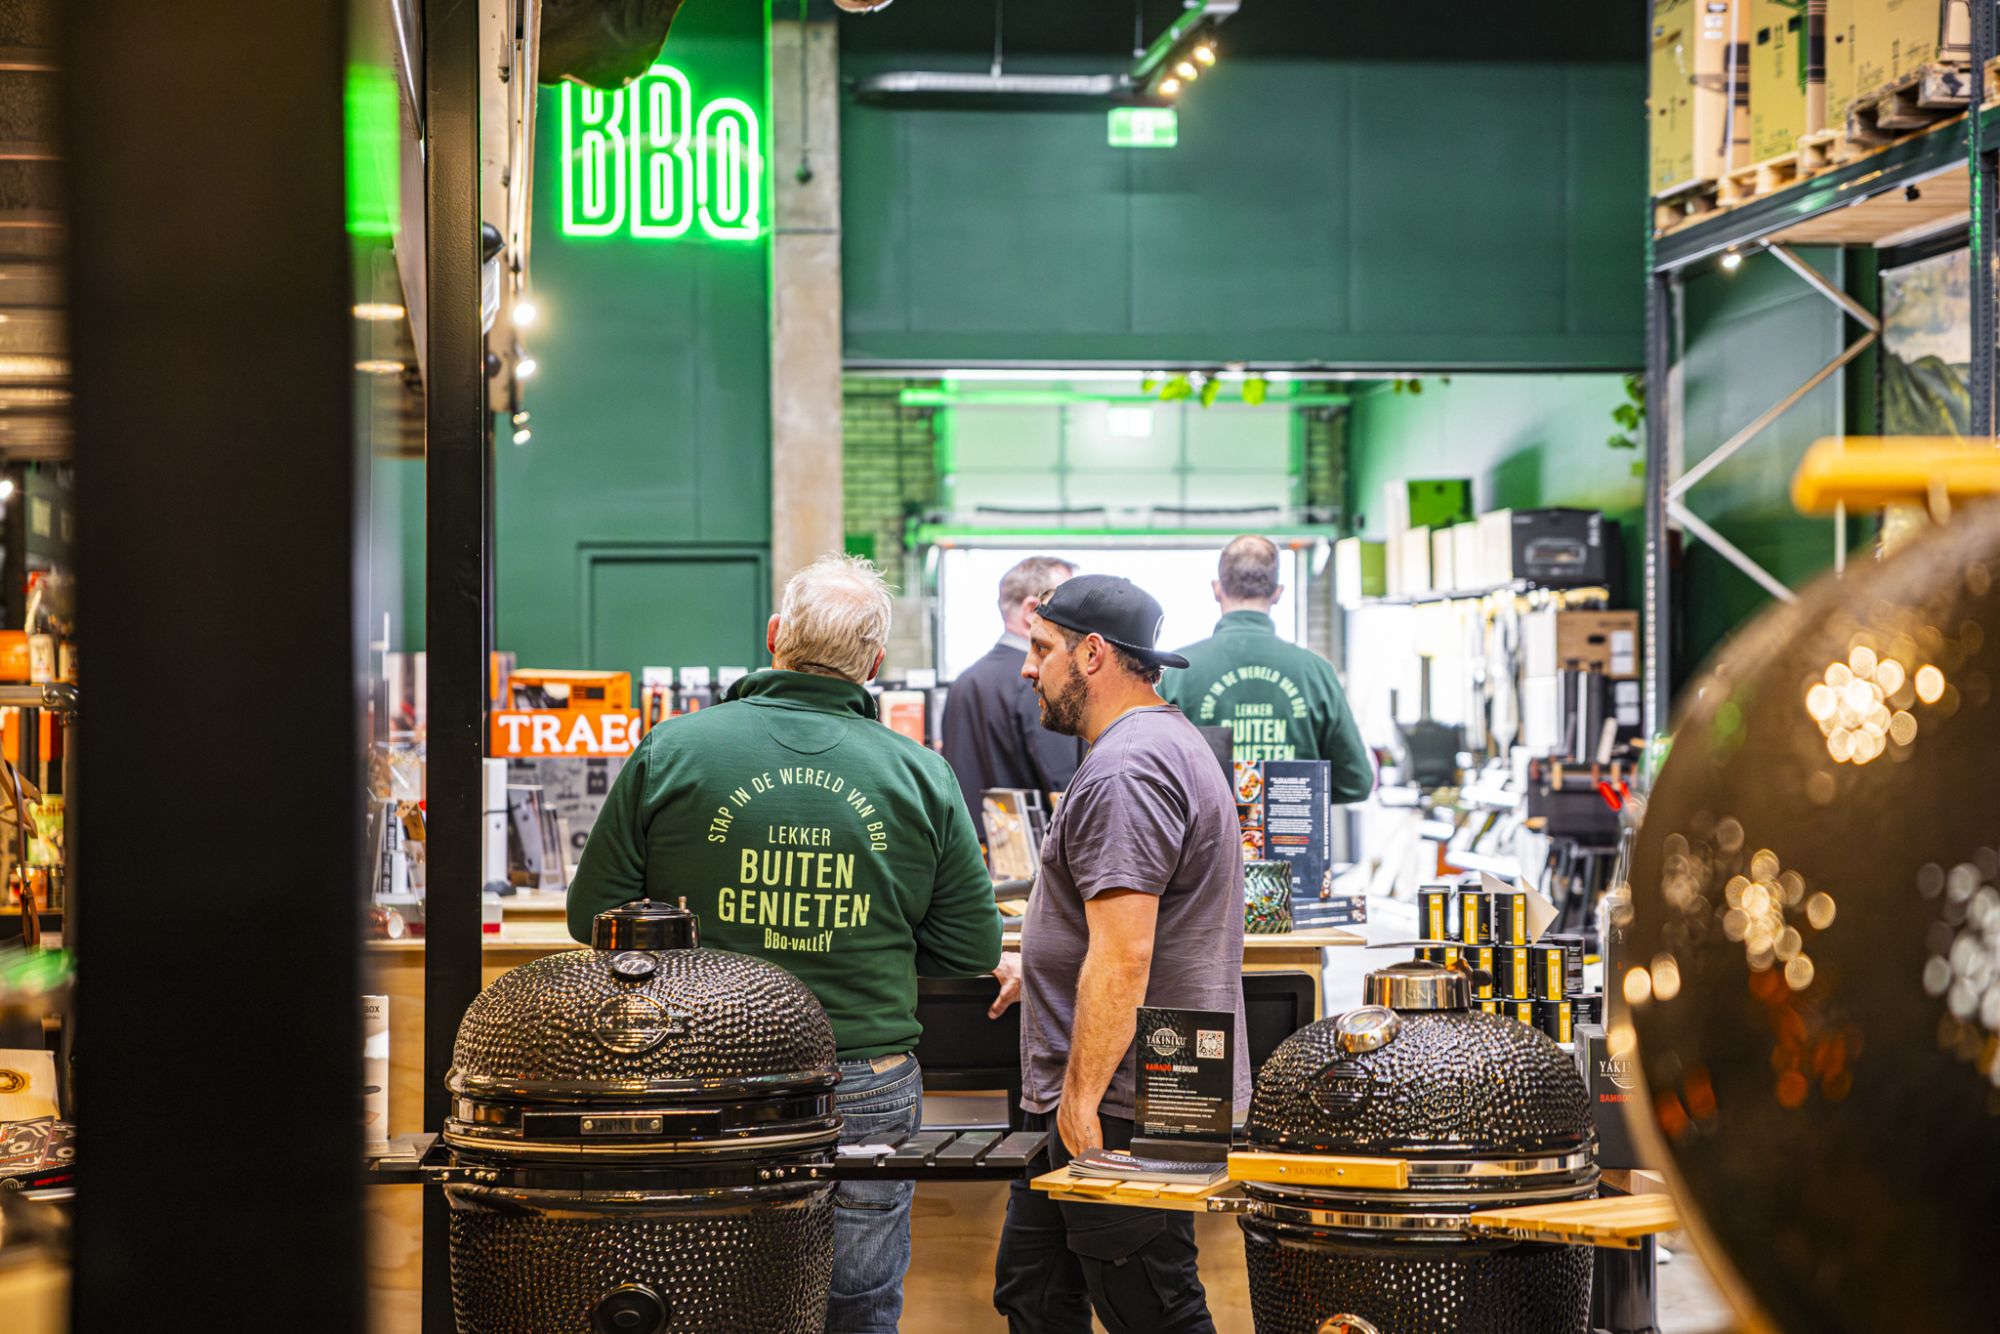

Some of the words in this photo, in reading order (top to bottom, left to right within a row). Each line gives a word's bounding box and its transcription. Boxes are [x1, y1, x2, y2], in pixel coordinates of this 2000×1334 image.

[708, 806, 734, 843] STAP
[729, 787, 752, 807] IN
[752, 772, 775, 794] DE
[779, 767, 845, 793] WERELD
[846, 788, 876, 818] VAN
[866, 821, 888, 852] BBQ
[768, 825, 831, 846] LEKKER
[740, 848, 855, 889] BUITEN
[718, 887, 870, 928] GENIETEN
[1146, 1035, 1186, 1046] YAKINIKU
[1173, 1064, 1198, 1073] MEDIUM
